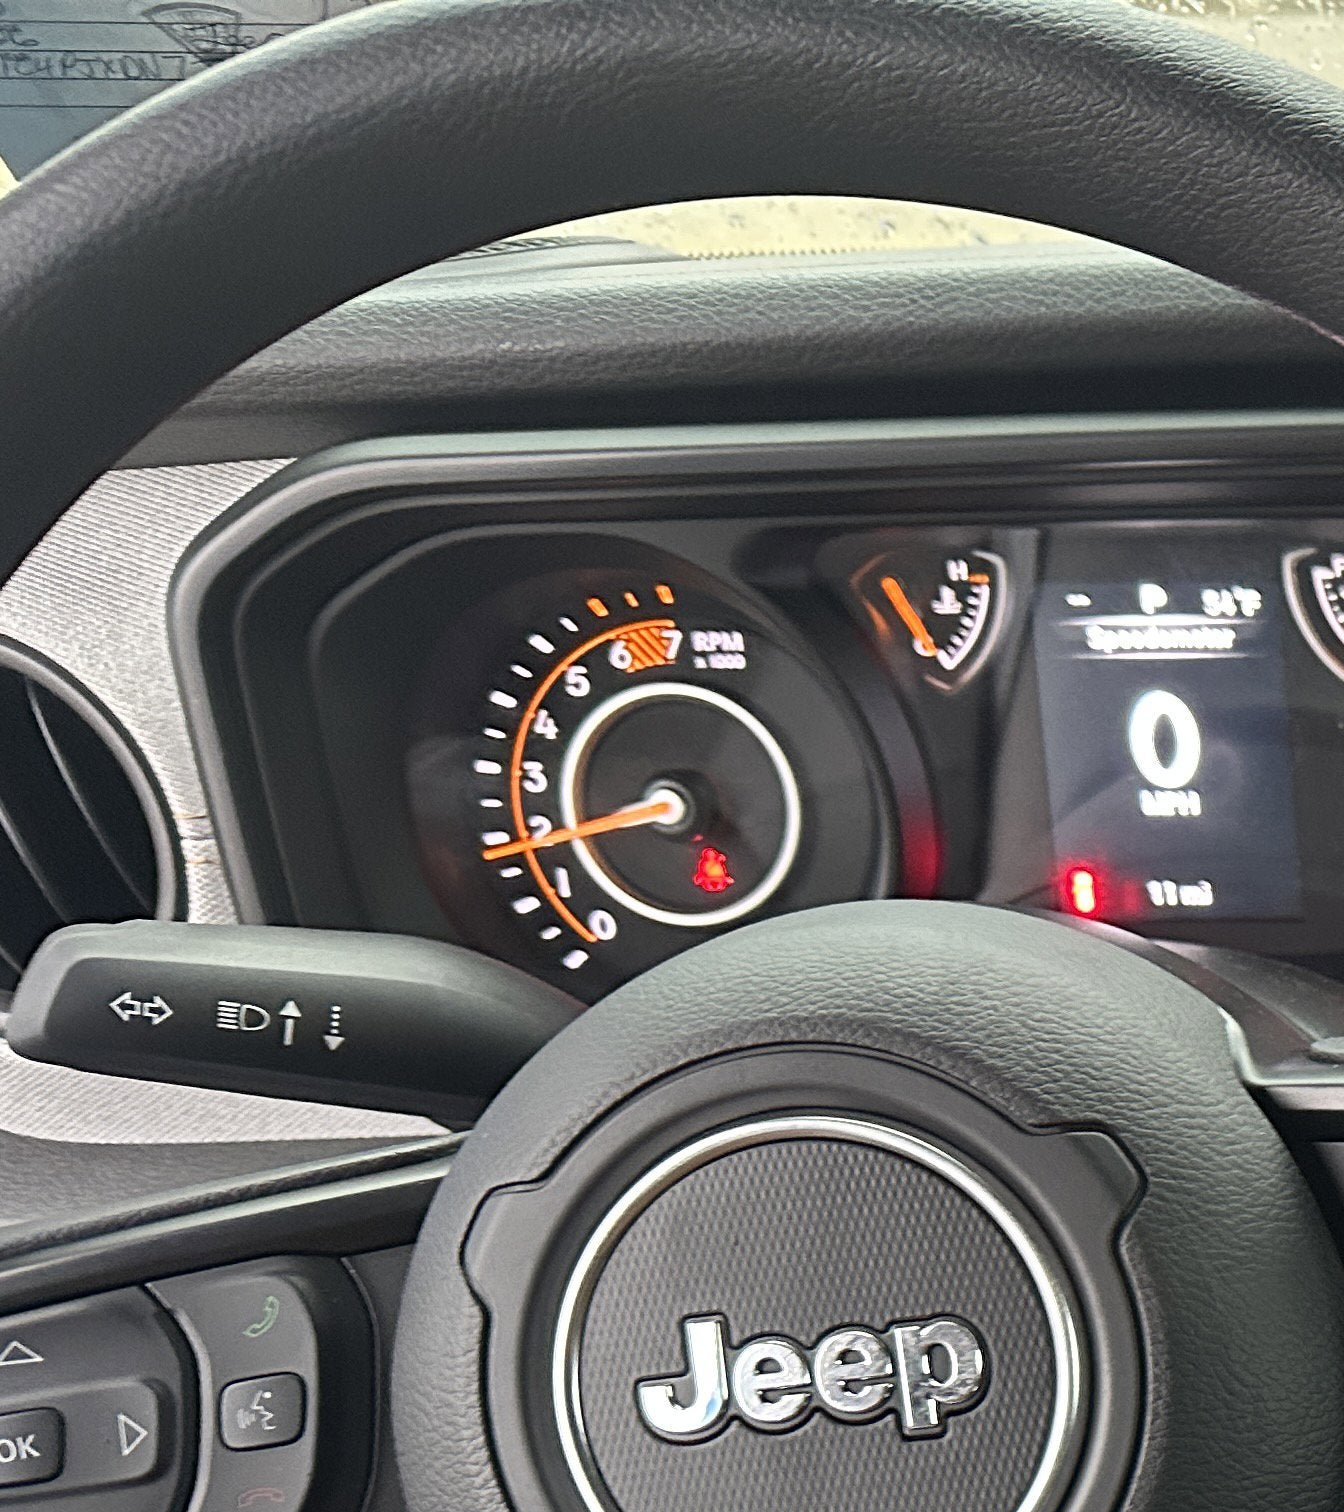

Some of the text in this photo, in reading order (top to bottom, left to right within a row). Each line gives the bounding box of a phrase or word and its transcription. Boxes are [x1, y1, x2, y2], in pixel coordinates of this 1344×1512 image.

[946, 559, 970, 582] H
[608, 640, 634, 671] 6
[660, 628, 684, 660] 7
[690, 630, 746, 653] RPM
[563, 665, 592, 698] 5
[532, 708, 561, 741] 4
[1128, 688, 1201, 790] 0
[521, 760, 549, 794] 3
[553, 866, 573, 899] 1
[586, 908, 619, 942] 0
[637, 1314, 987, 1438] Jeep
[0, 1432, 43, 1465] OK
